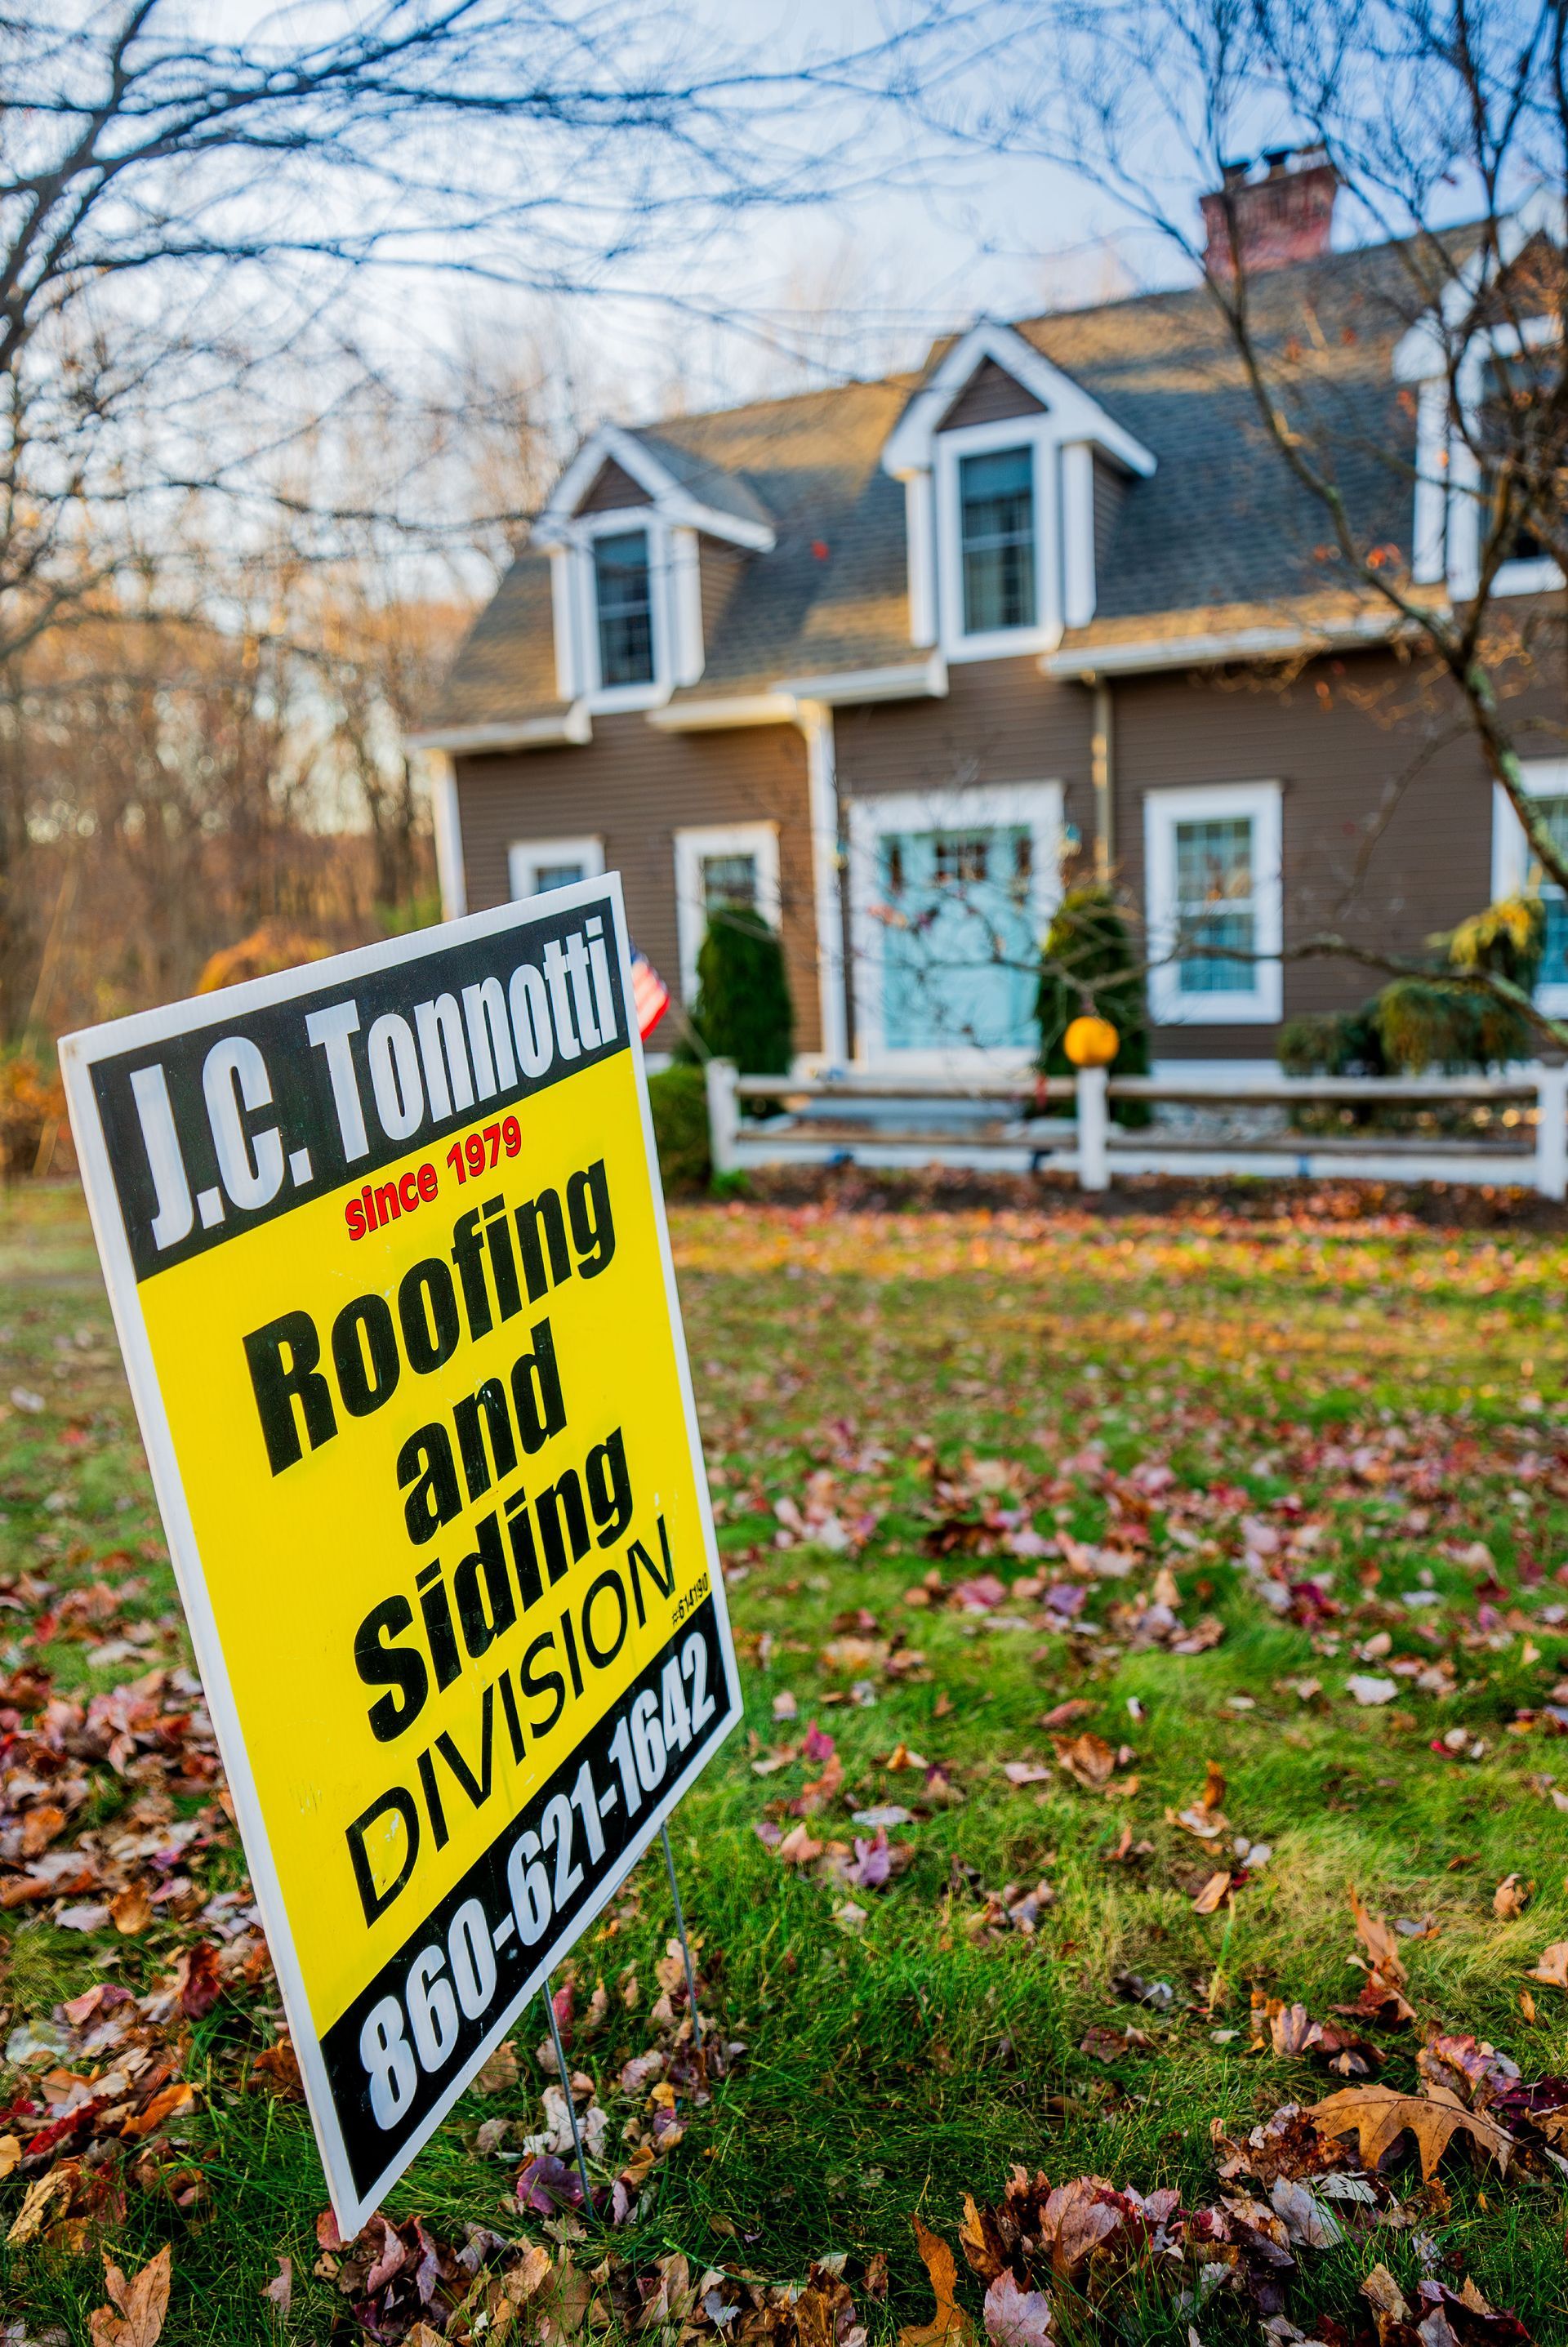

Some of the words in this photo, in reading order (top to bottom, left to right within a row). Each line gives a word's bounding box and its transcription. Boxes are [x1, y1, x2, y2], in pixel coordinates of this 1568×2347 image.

[130, 1037, 314, 1251] J.C.
[305, 916, 619, 1164] Tonnotti
[345, 1162, 439, 1242] since
[446, 1116, 522, 1187] 1979
[242, 1159, 617, 1477] Roofing
[396, 1319, 568, 1547] and
[345, 1514, 676, 1928] DIVISION
[353, 1427, 633, 1743] Siding
[359, 1632, 716, 2131] 860-621-1642
